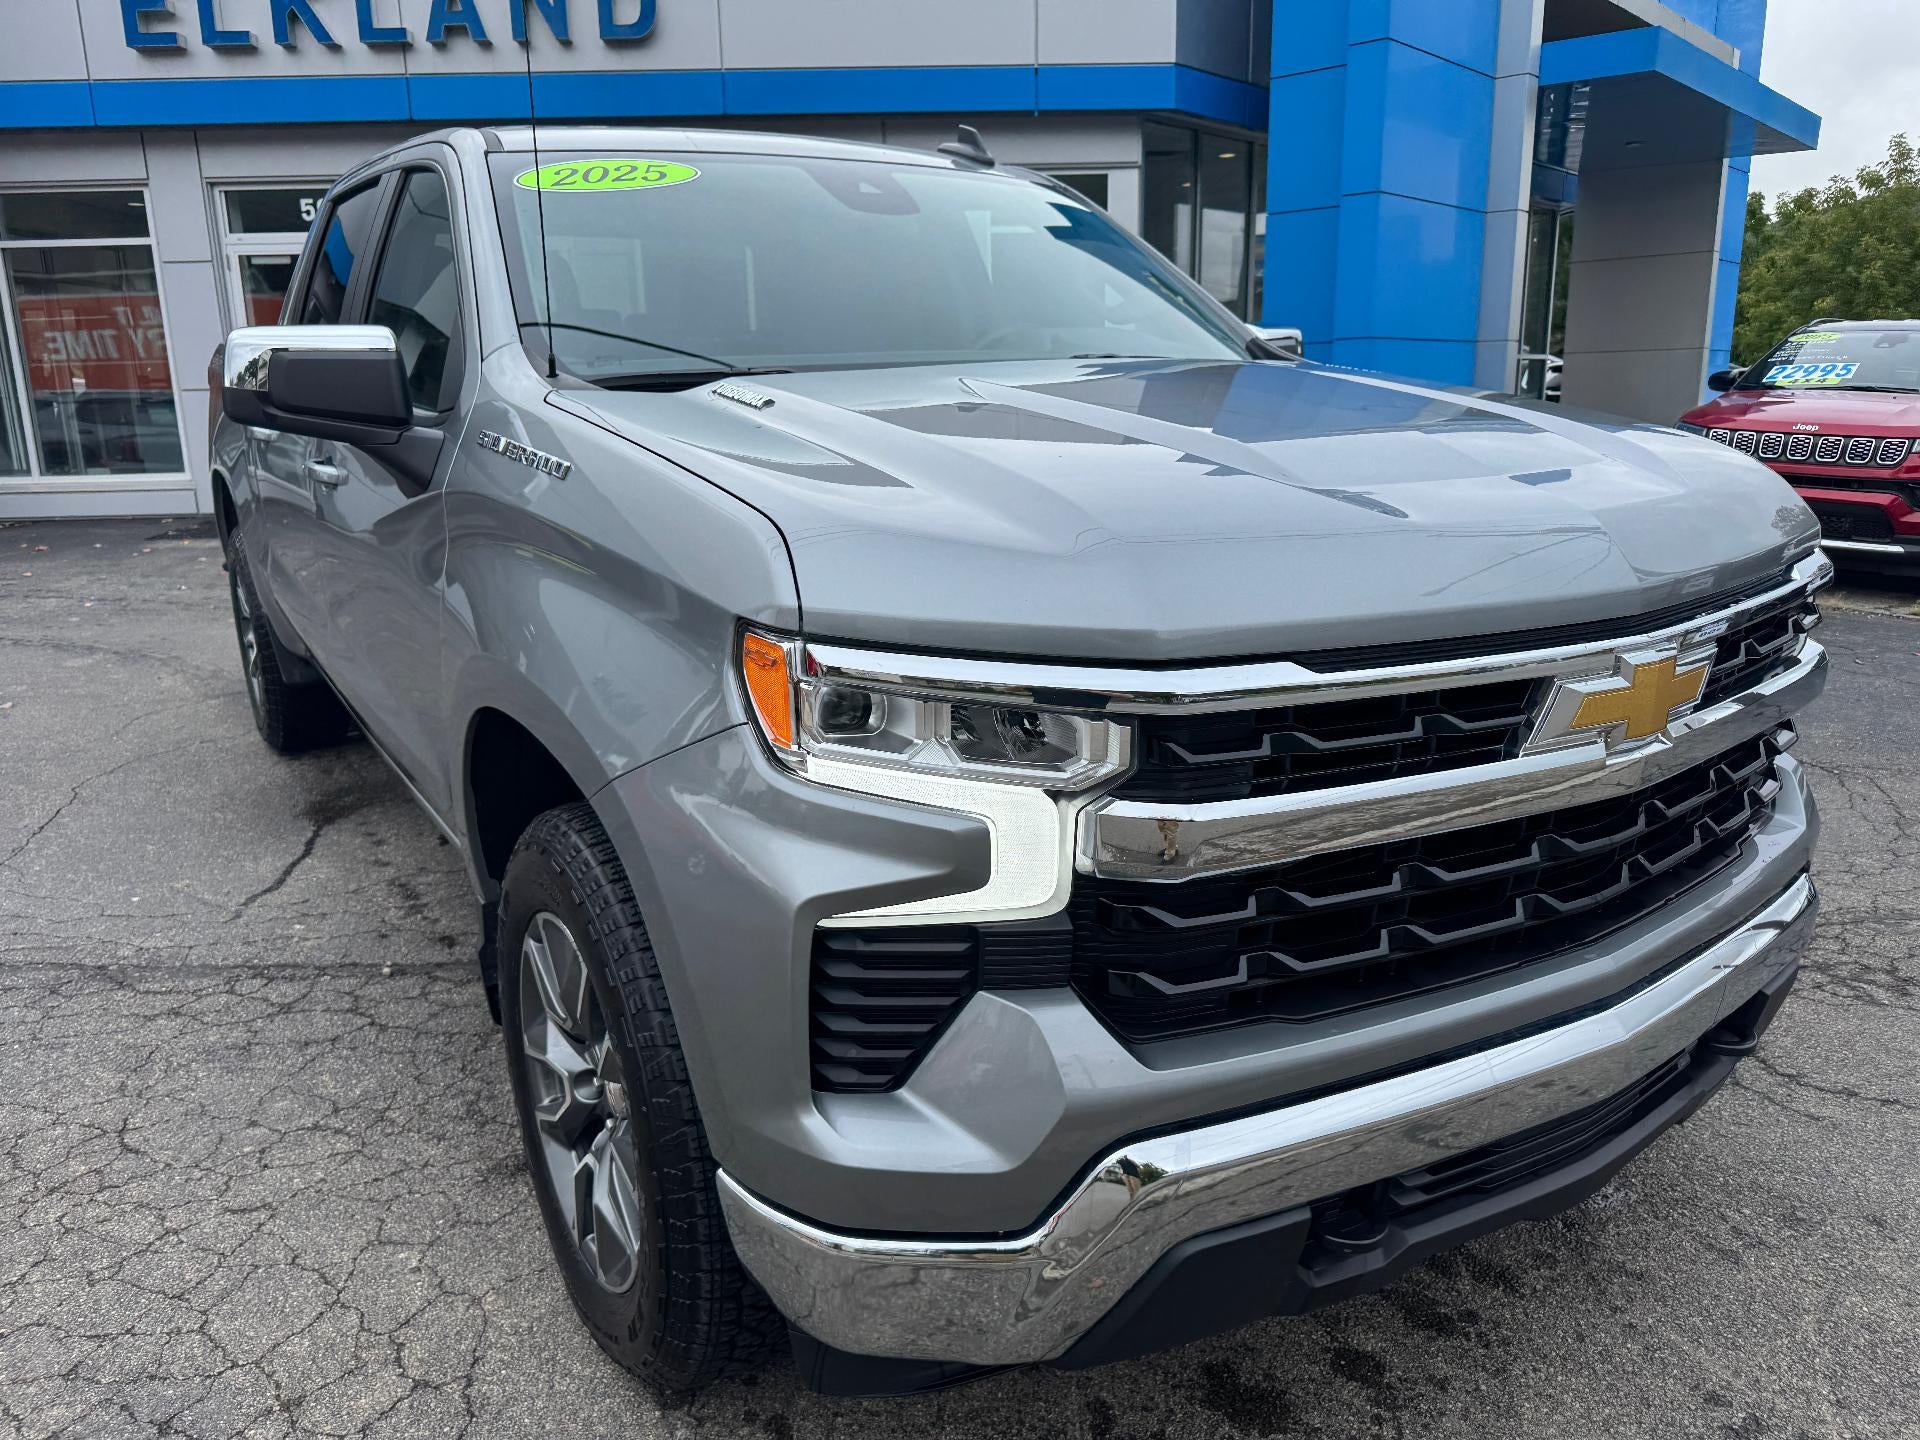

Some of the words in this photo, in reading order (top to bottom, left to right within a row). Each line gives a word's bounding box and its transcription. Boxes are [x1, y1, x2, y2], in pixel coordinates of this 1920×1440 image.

[119, 0, 657, 50] ELKLAND
[550, 164, 668, 187] 2025
[1765, 363, 1855, 381] 22995
[1792, 423, 1819, 432] Jeep
[477, 430, 571, 480] SILVERADO
